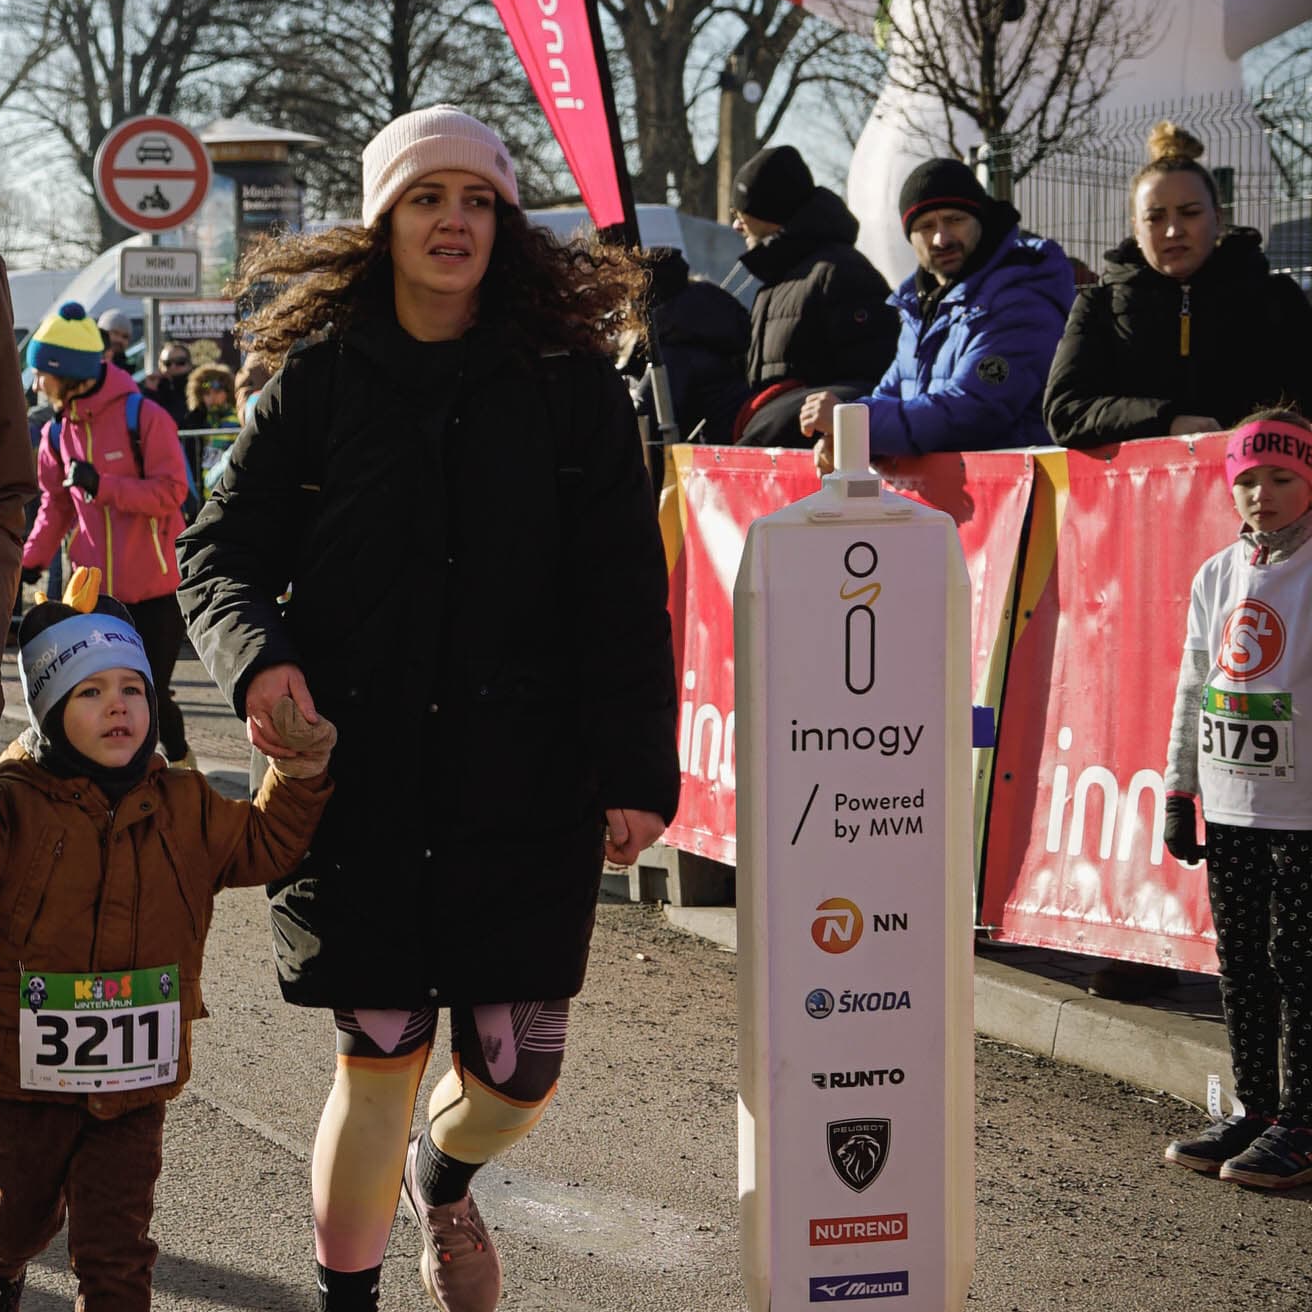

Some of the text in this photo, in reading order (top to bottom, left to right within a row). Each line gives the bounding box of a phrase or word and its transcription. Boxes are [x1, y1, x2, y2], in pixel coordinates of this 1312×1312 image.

[791, 720, 924, 756] innogy
[1202, 715, 1279, 763] 3179
[834, 789, 924, 812] Powered
[1046, 726, 1206, 870] inn
[834, 816, 923, 842] by MVM
[872, 913, 908, 932] NN
[838, 990, 911, 1013] ŠKODA
[36, 1011, 159, 1066] 3211
[830, 1068, 905, 1088] RUNTO
[833, 1125, 885, 1134] PEUGEOT
[815, 1220, 903, 1240] NUTREND
